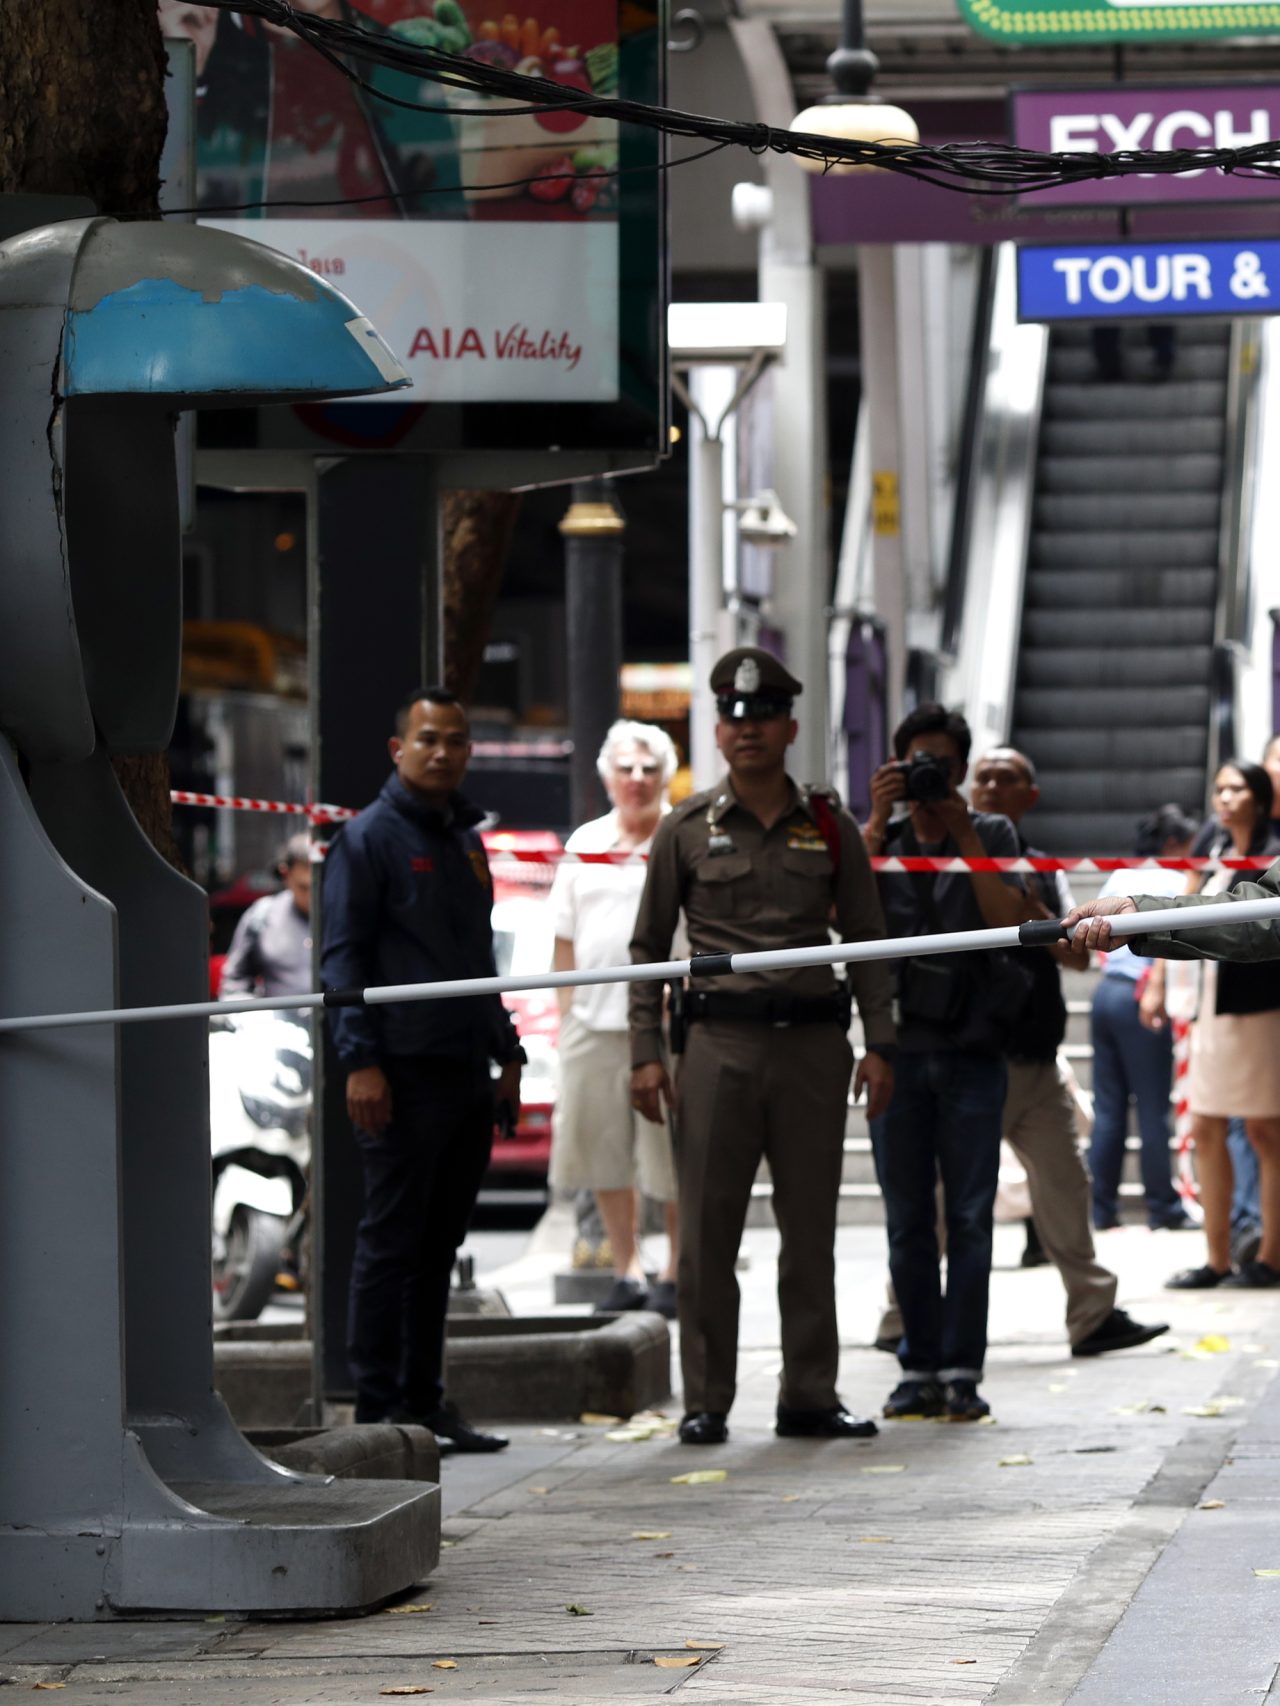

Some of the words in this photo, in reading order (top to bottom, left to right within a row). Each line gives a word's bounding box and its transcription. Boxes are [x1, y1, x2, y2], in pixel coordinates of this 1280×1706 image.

[1053, 254, 1212, 303] TOUR
[1229, 250, 1270, 299] &
[408, 327, 487, 360] AIA
[494, 322, 584, 371] Vitality
